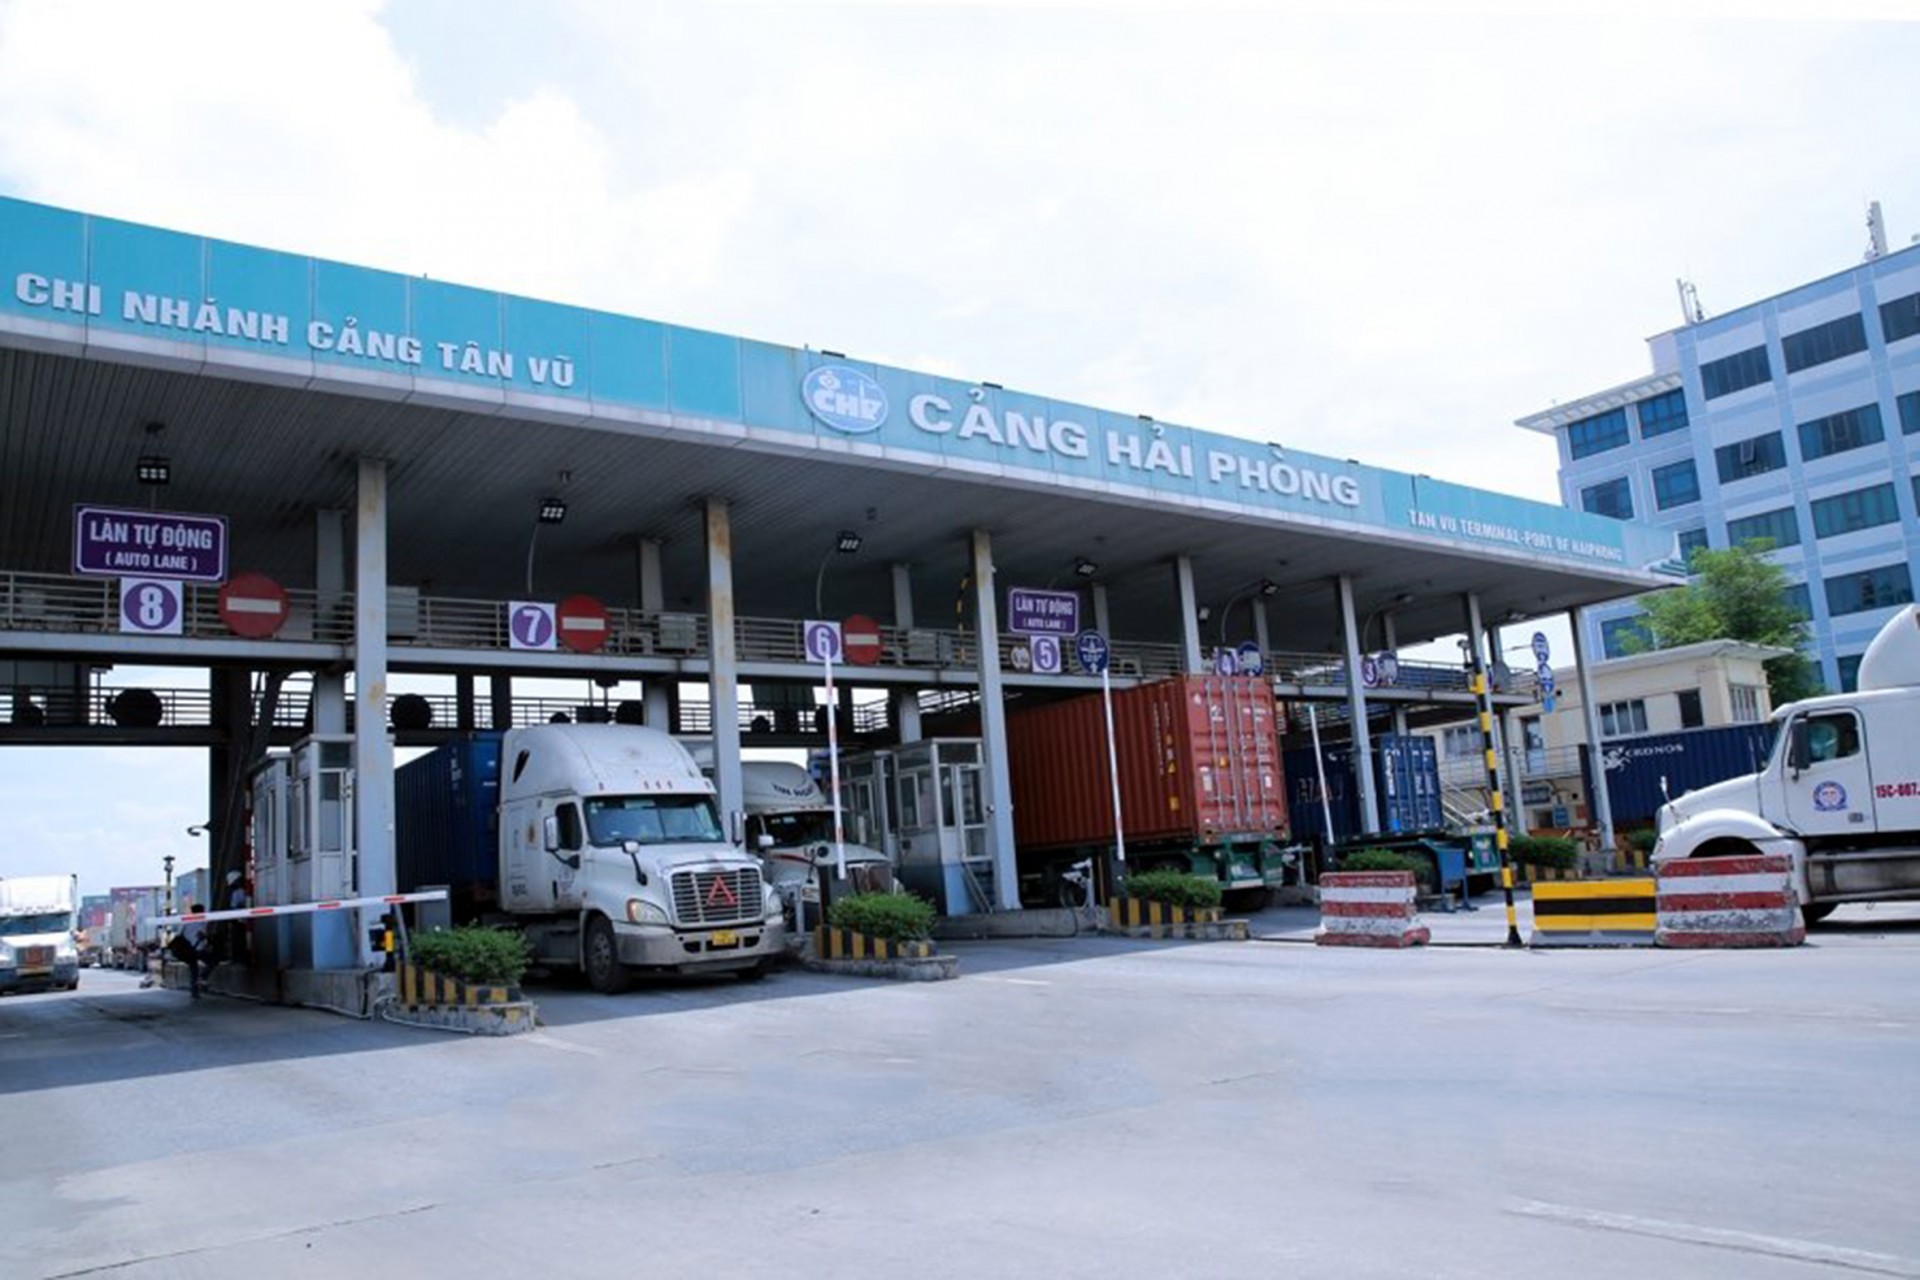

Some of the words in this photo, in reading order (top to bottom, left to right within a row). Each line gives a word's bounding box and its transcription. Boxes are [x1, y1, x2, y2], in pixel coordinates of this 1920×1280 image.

[16, 272, 101, 316] CHI
[122, 291, 289, 344] NHÁNH
[307, 316, 422, 365] CẢNG
[437, 340, 513, 379] TÂN
[528, 354, 574, 388] VŨ
[909, 387, 1088, 459] CẢNG
[1106, 424, 1194, 479] HẢI
[1207, 449, 1360, 507] PHÒNG
[1408, 510, 1436, 528] TAN
[90, 518, 129, 543] LÀN
[133, 524, 160, 549] TỰ
[161, 524, 213, 551] ĐỘNG
[114, 552, 150, 567] AUTO
[154, 554, 189, 570] LANE
[139, 585, 164, 626] 8
[521, 610, 541, 643] 7
[815, 630, 830, 655] 6
[1040, 641, 1053, 668] 5
[1364, 661, 1375, 682] 3
[1625, 743, 1684, 757] CRONOS
